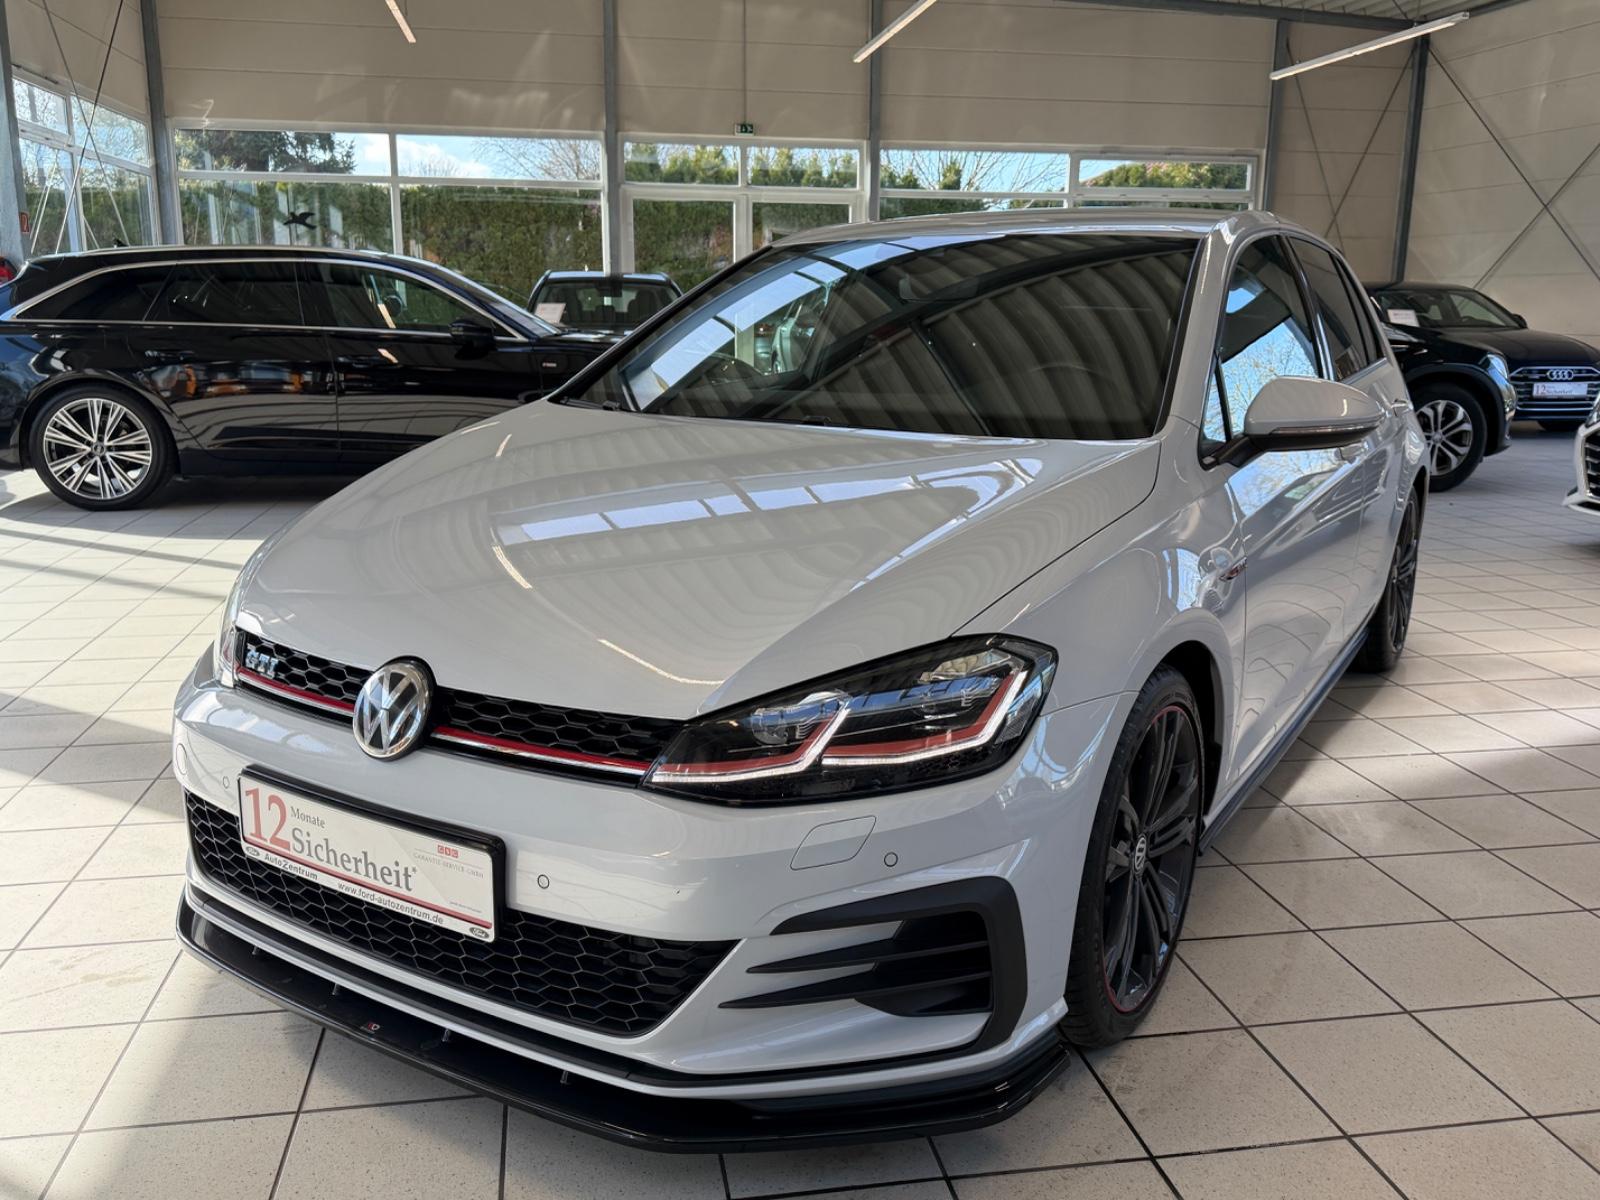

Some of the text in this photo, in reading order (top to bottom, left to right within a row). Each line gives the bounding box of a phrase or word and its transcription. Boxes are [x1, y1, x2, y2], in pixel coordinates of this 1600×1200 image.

[245, 787, 291, 850] 12
[290, 806, 325, 829] Monate
[264, 853, 318, 880] AutoZentrum
[338, 882, 444, 924] www.ford-autozentrum.de
